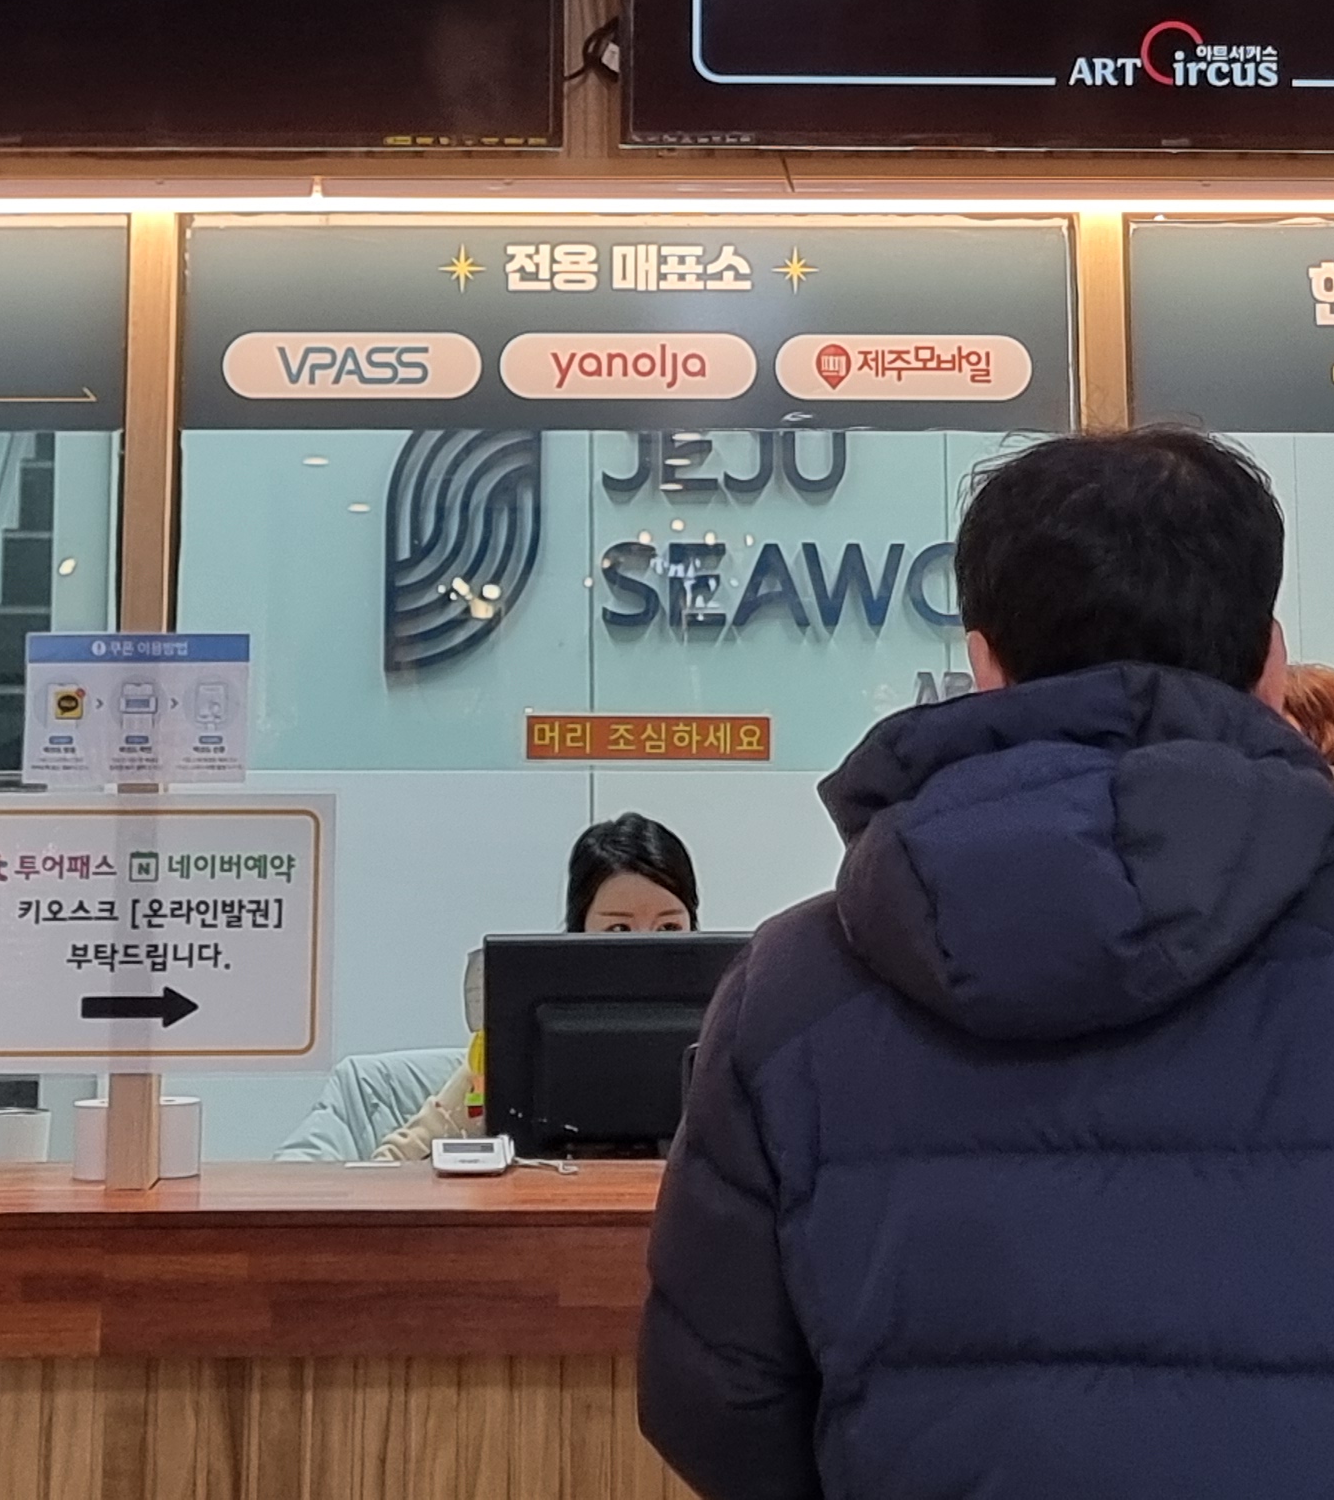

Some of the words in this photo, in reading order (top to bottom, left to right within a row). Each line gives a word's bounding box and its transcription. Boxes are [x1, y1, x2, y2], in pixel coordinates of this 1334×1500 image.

[1069, 57, 1142, 86] ART
[503, 243, 599, 293] 전용
[611, 242, 753, 294] 매표소
[276, 345, 430, 386] VPASS
[550, 343, 707, 390] yanolja
[857, 345, 992, 385] 제주모바일
[602, 431, 847, 492] JEJU
[601, 541, 963, 627] SEAWO
[533, 721, 592, 754] 머리
[607, 721, 765, 753] 조심하세요
[14, 853, 118, 881] 투어패스
[167, 853, 297, 884] 네이버예약
[17, 899, 120, 926] 키오스크
[130, 897, 284, 930] [온라인발권]
[66, 942, 233, 973] 부탁드립니다.
